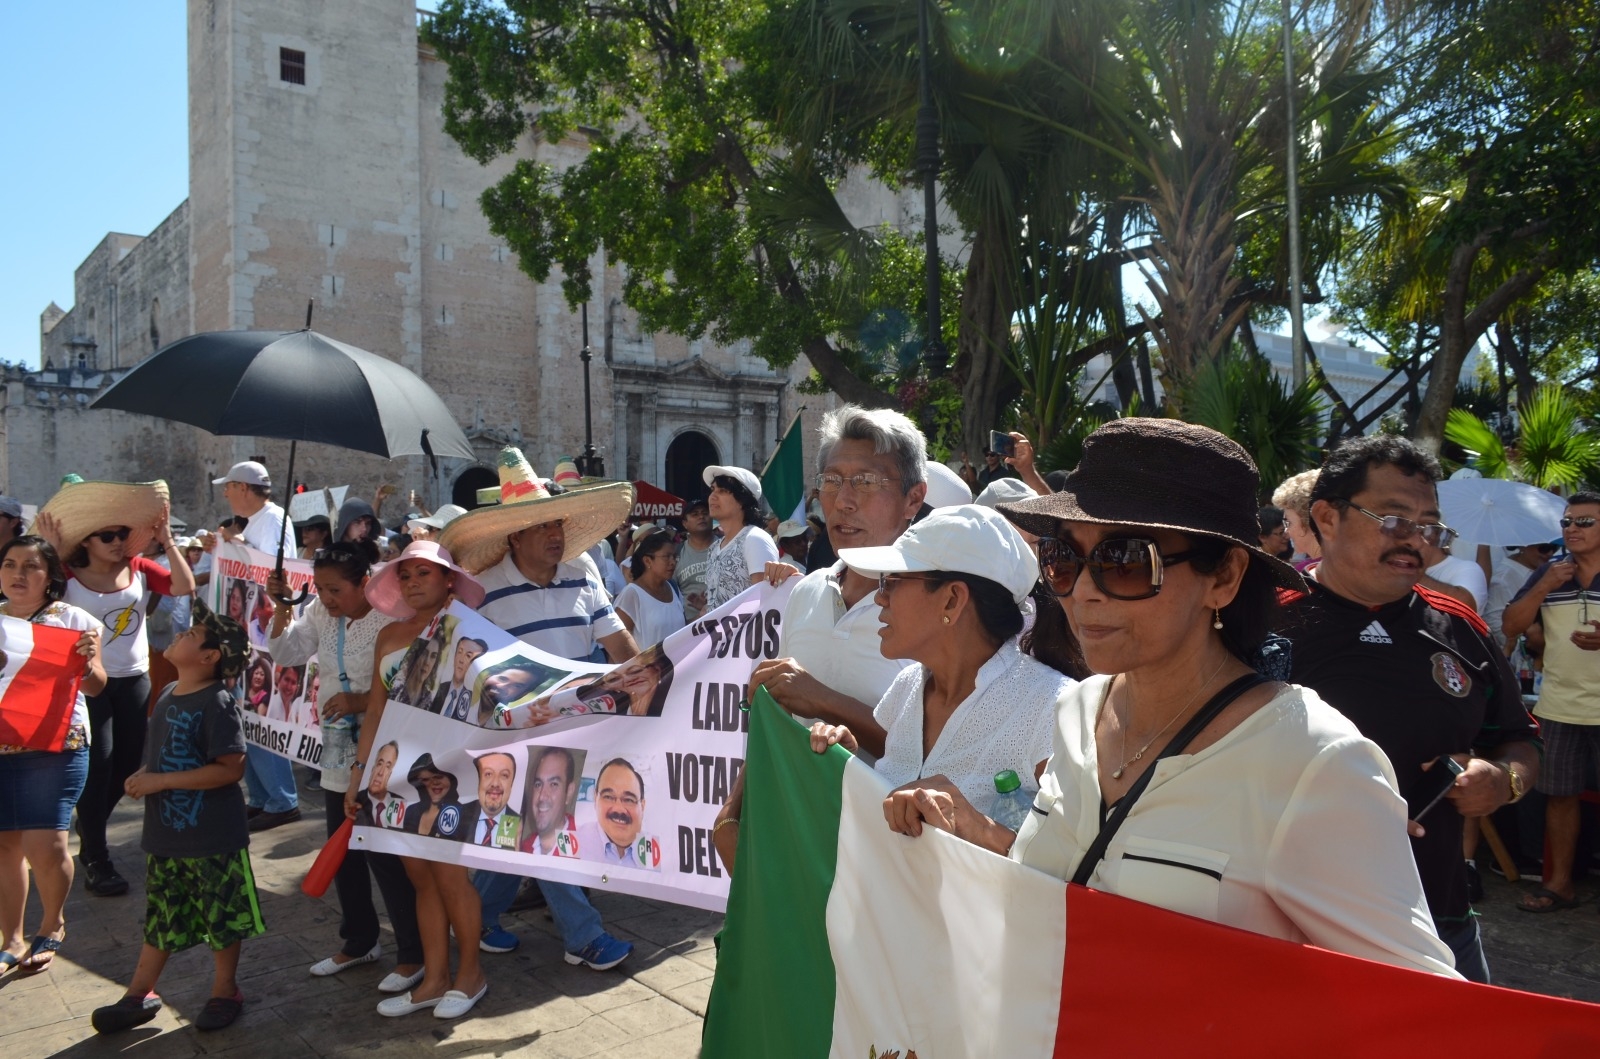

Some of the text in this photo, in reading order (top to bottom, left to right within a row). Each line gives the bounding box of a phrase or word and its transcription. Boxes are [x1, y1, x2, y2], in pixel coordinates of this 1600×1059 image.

[632, 503, 683, 516] OYADAS
[1359, 635, 1393, 644] adidas
[442, 812, 458, 828] PAN
[496, 835, 515, 846] VERDE
[558, 834, 578, 851] PRI
[639, 839, 660, 863] PRI
